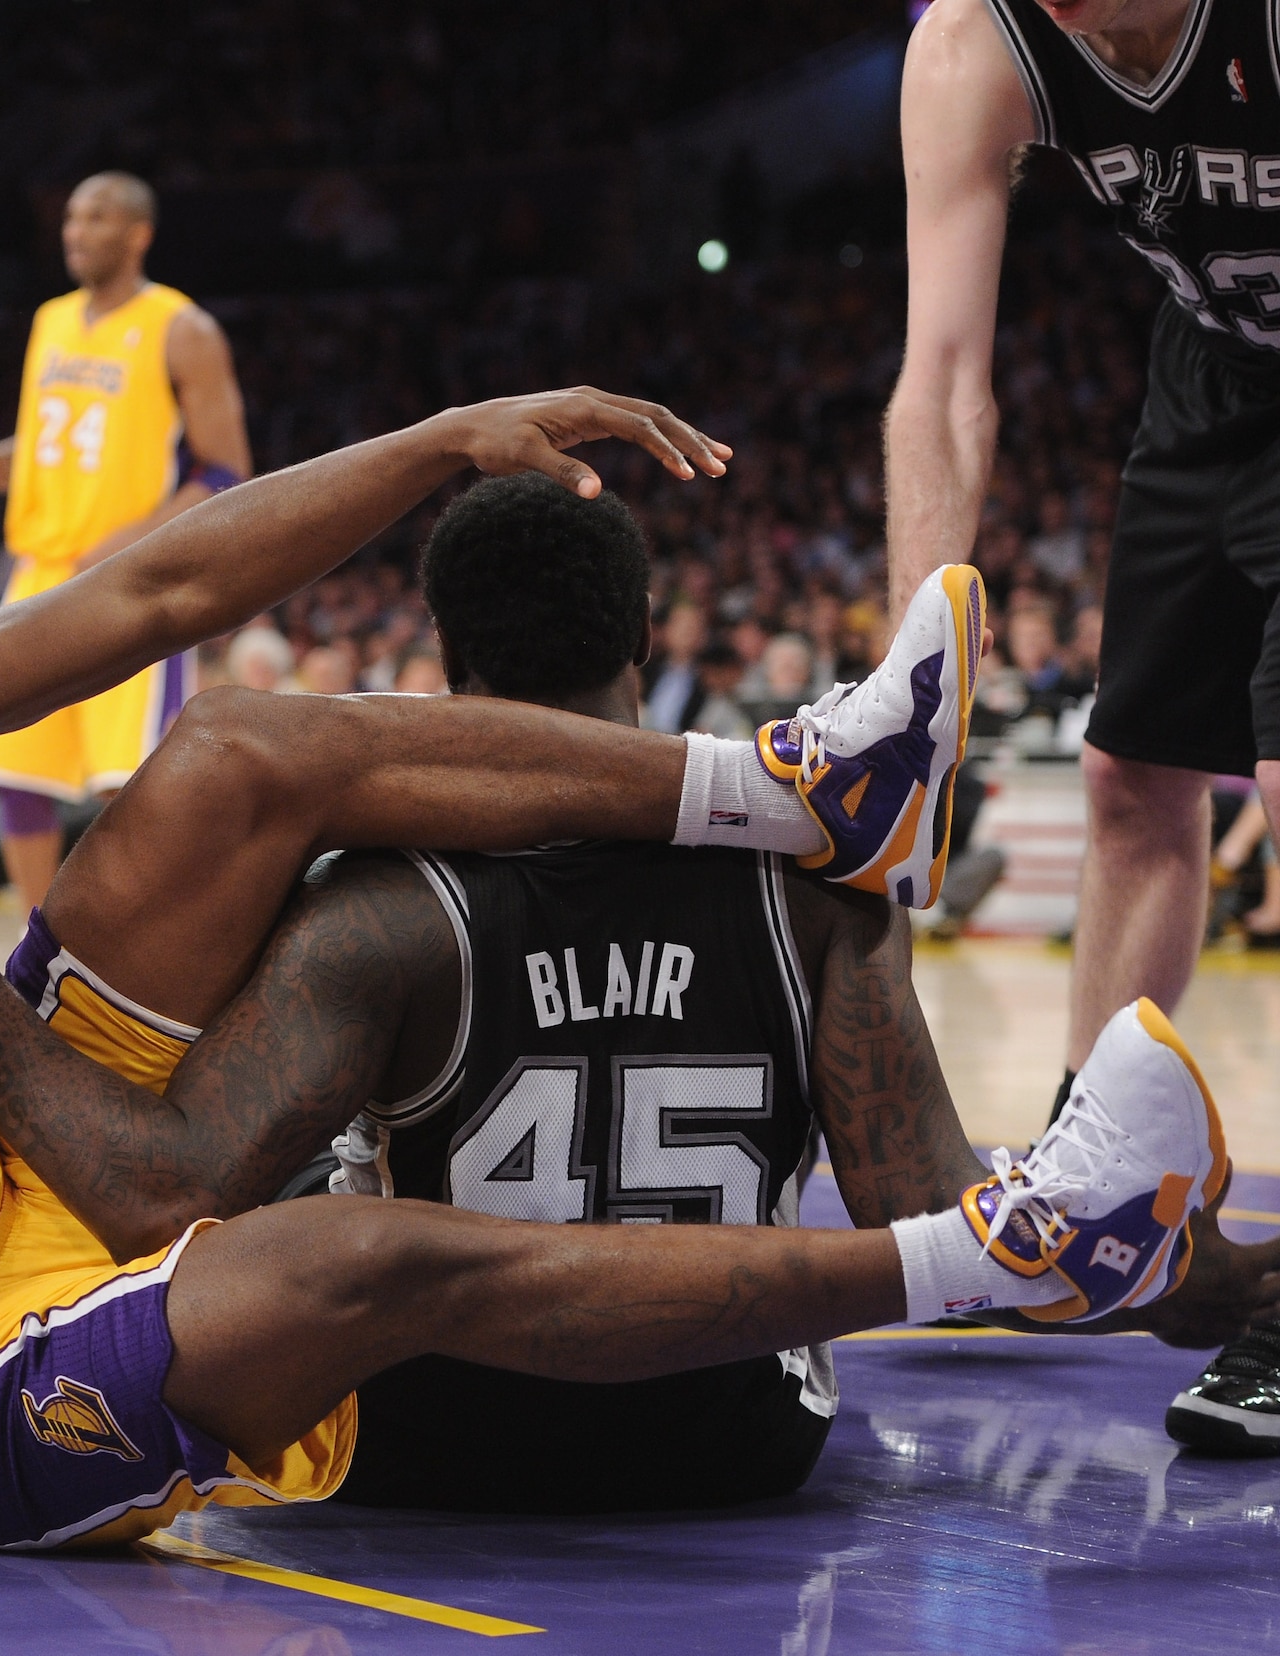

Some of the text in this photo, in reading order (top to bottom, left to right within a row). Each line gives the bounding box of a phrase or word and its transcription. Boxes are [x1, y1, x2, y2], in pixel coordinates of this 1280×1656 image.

[1066, 143, 1280, 238] PURS
[36, 397, 107, 472] 24
[525, 941, 695, 1028] BLAIR
[444, 1054, 773, 1225] 45
[1088, 1235, 1140, 1276] B
